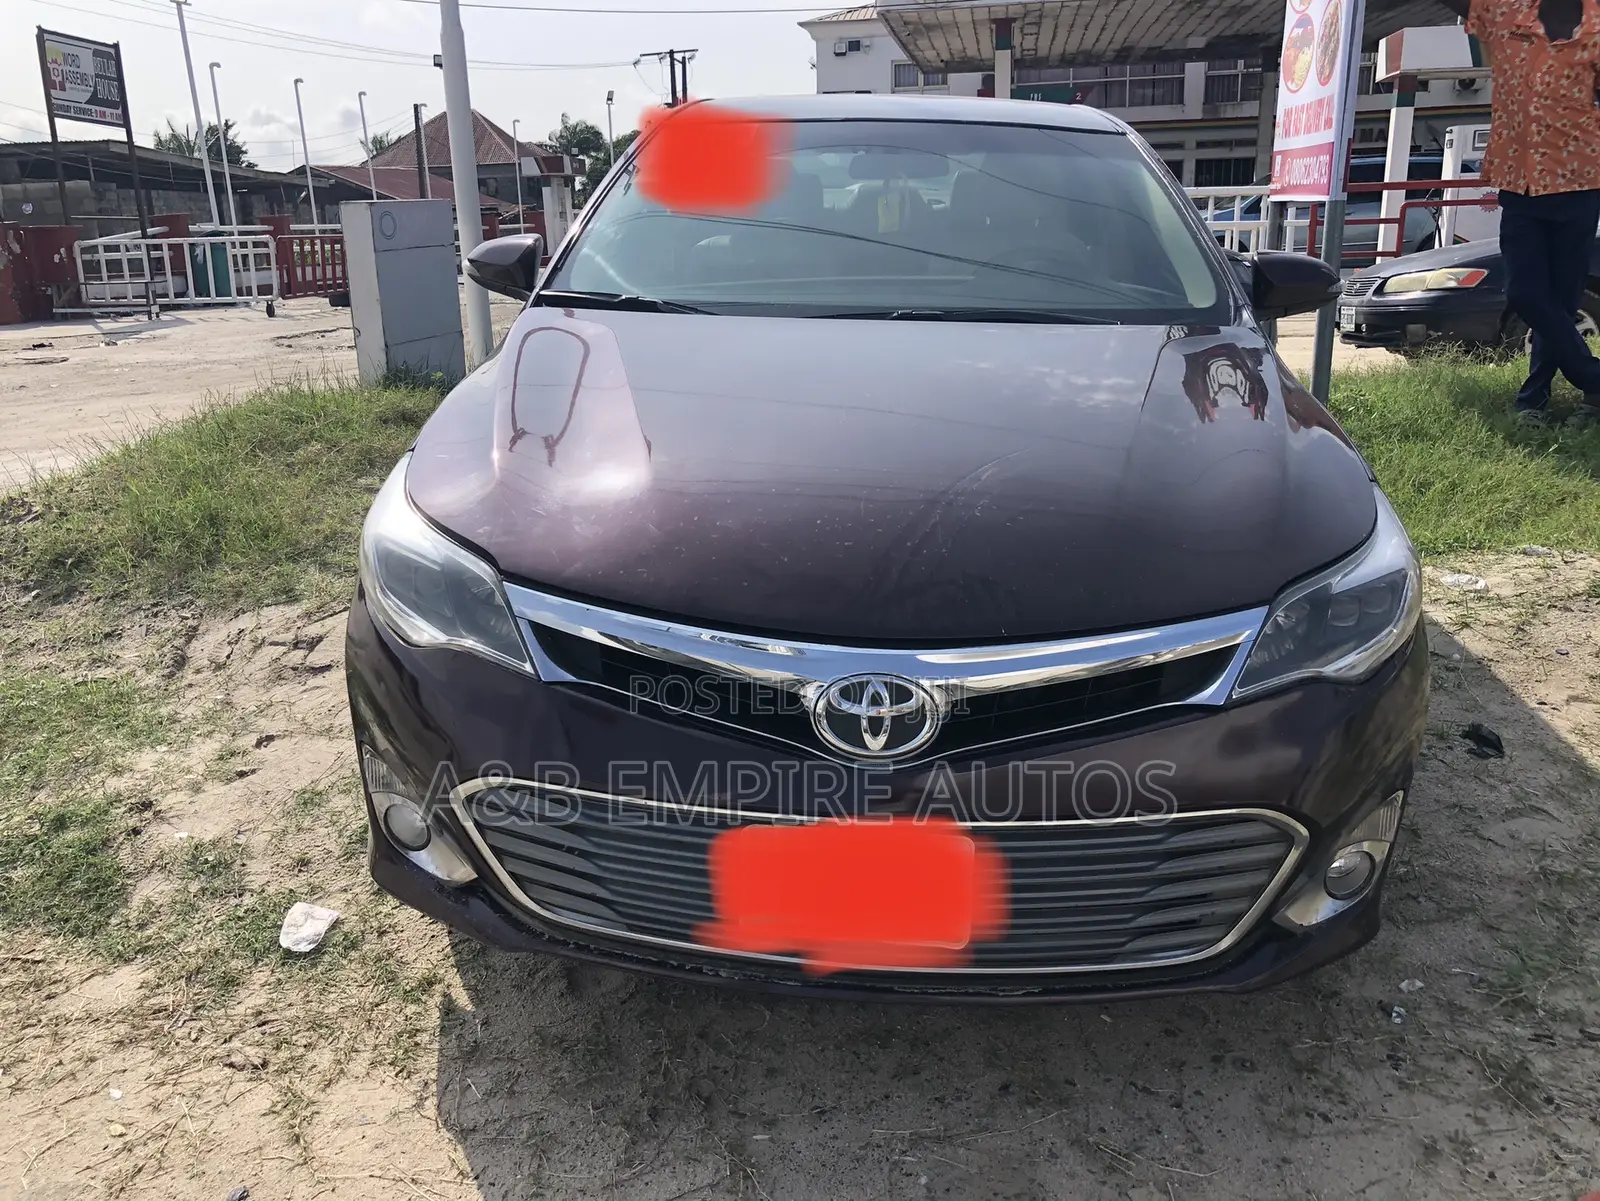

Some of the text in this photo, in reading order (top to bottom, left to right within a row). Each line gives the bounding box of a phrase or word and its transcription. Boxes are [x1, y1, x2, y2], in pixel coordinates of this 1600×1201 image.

[63, 53, 80, 68] WORD
[64, 68, 94, 88] ASSEMBLY
[96, 78, 120, 101] HOUSE
[53, 103, 72, 113] SUNDAY
[1282, 107, 1294, 139] FOR
[1292, 103, 1306, 136] FAST
[1303, 96, 1327, 135] DELIVERY
